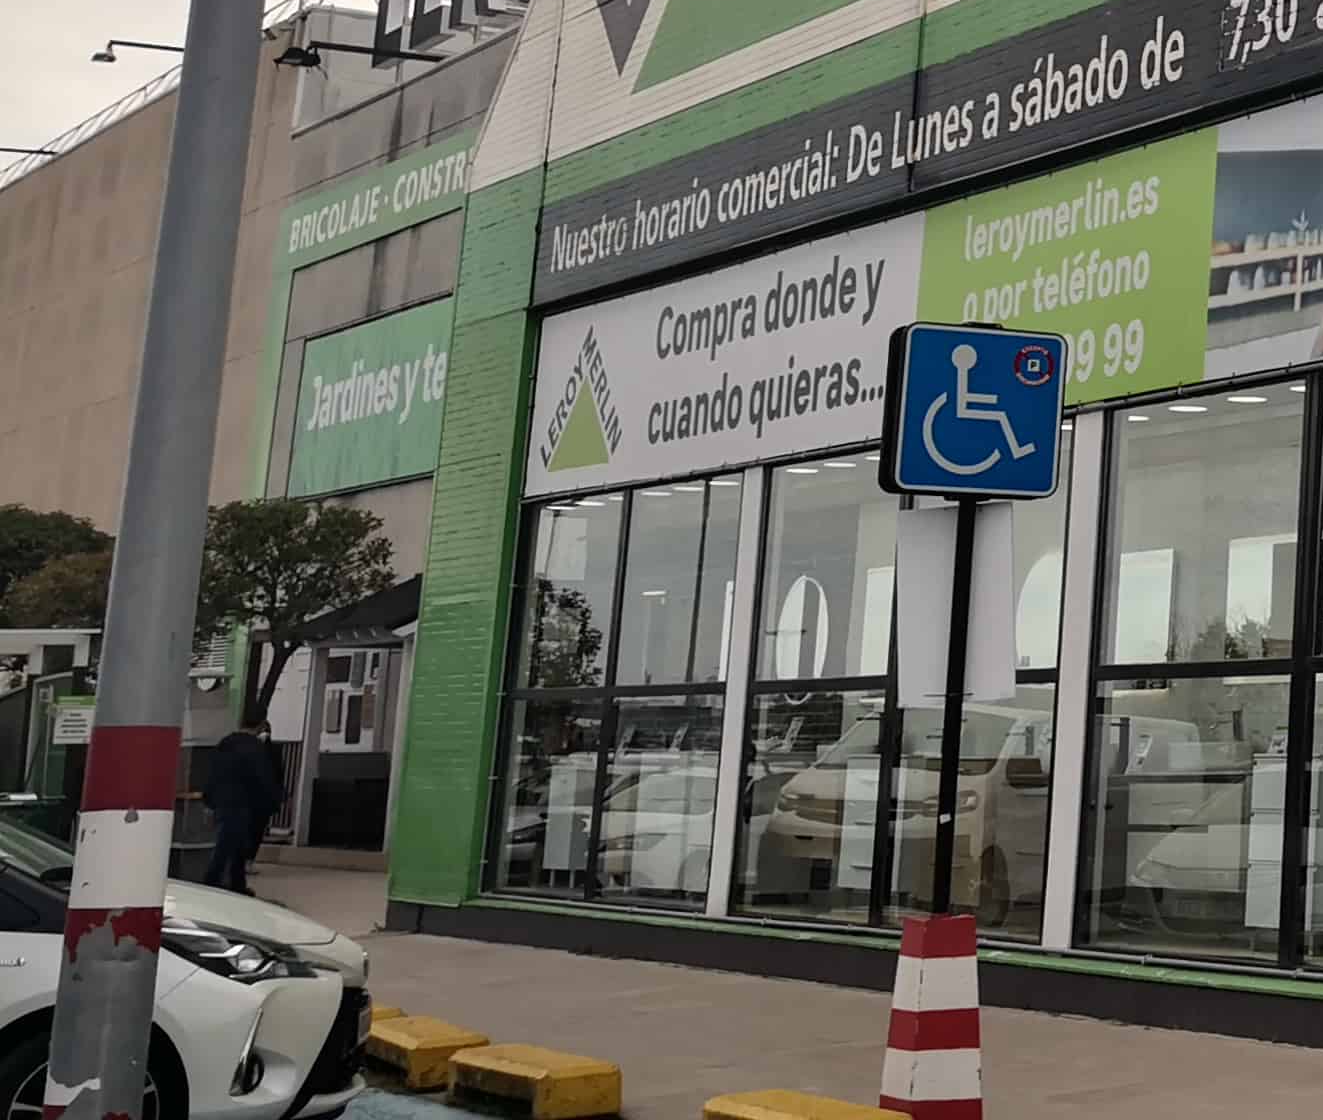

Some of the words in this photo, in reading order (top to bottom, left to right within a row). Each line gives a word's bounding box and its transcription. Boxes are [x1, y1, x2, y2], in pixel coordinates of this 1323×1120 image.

[551, 214, 627, 272] Nuestro
[632, 178, 710, 250] horario
[717, 130, 839, 222] comercial:
[847, 124, 882, 184] De
[891, 99, 974, 169] Lunes
[982, 92, 1000, 140] a
[1010, 35, 1128, 132] sábado
[1141, 16, 1185, 91] de
[289, 186, 381, 254] BRICOLAJE
[393, 146, 475, 213] CONSTR
[965, 176, 1160, 263] leroymerlin.es
[657, 294, 757, 361] Compra
[764, 255, 856, 333] donde
[862, 259, 885, 326] y
[963, 292, 978, 322] o
[983, 279, 1027, 324] por
[1033, 248, 1151, 312] teléfono
[1103, 319, 1145, 377] 99
[307, 358, 400, 431] Jardines
[399, 359, 420, 424] y
[540, 352, 583, 468] LEROY
[581, 325, 622, 456] MERLIN
[648, 372, 743, 445] cuando
[750, 355, 884, 438] quieras...
